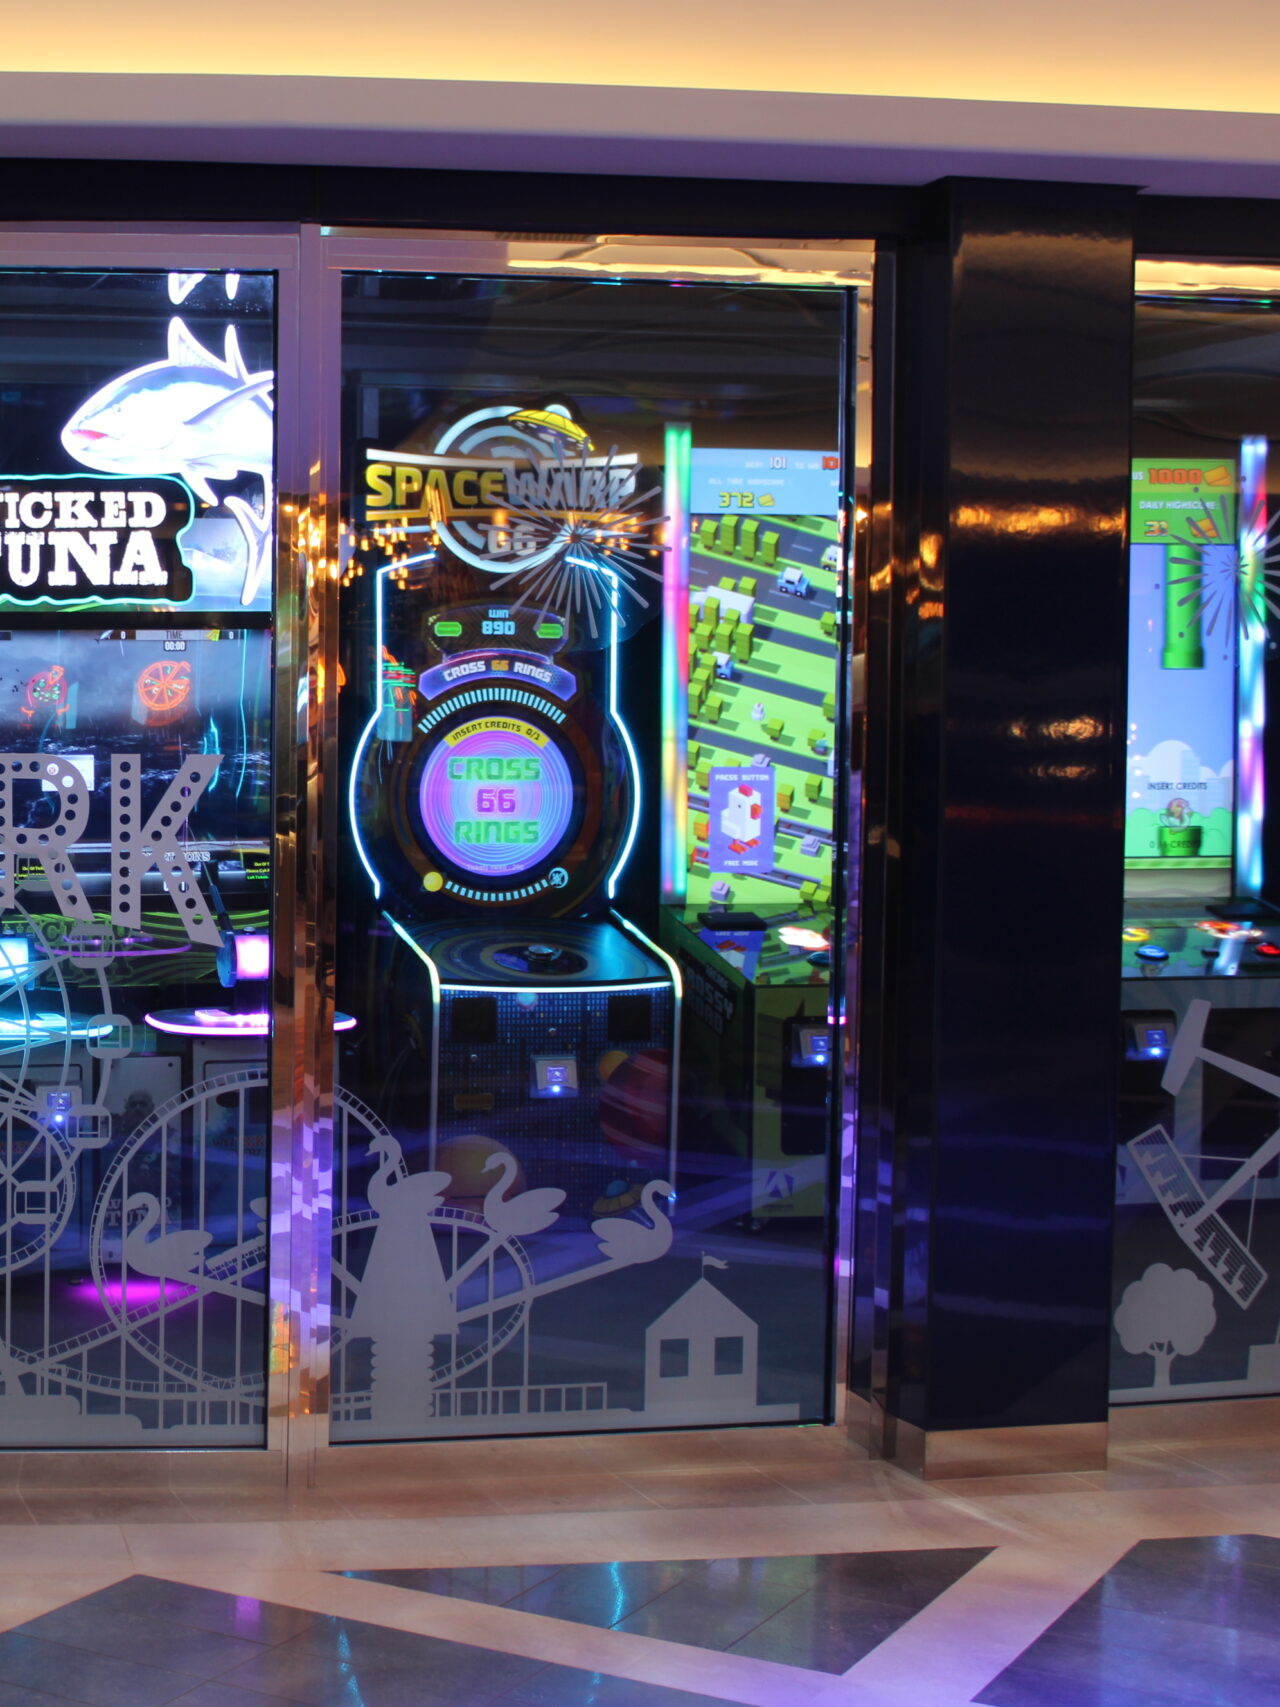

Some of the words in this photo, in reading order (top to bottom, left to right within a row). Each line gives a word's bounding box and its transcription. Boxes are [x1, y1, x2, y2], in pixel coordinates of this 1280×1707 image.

[1149, 468, 1202, 485] 1000
[719, 491, 754, 507] 372
[166, 630, 183, 640] TIME
[481, 620, 516, 635] 890
[164, 640, 186, 651] 00:00
[443, 660, 487, 683] CROSS
[513, 660, 553, 684] RINGS
[452, 722, 484, 742] INSERT
[485, 720, 522, 735] CREDITS
[448, 756, 541, 781] CROSS
[1176, 782, 1207, 790] CREDITS
[477, 788, 516, 813] 66
[454, 820, 540, 844] RINGS
